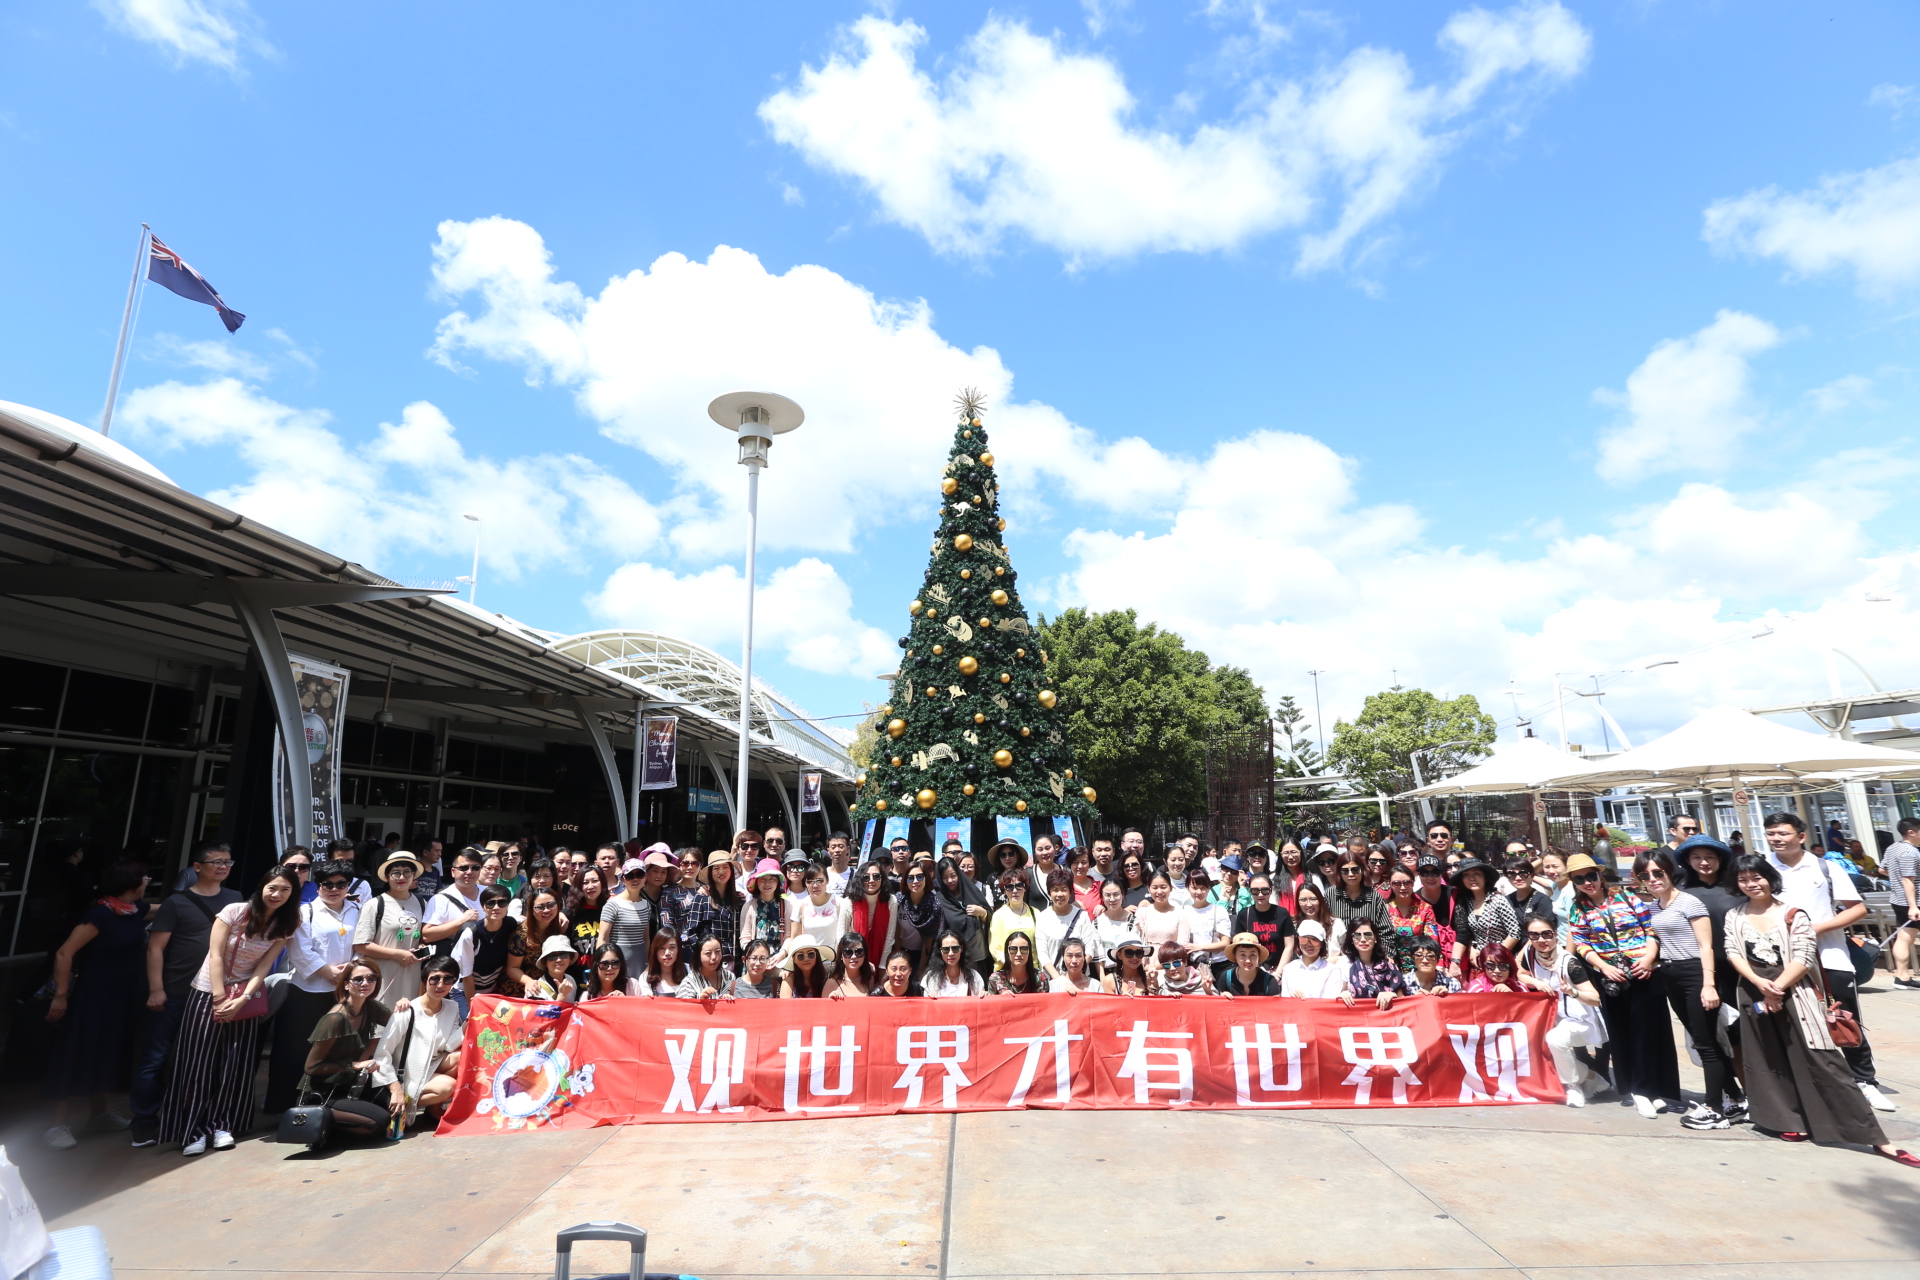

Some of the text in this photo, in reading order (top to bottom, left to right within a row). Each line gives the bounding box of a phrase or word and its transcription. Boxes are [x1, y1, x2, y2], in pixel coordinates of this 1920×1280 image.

[313, 810, 325, 820] TO
[313, 824, 329, 834] THE
[661, 1019, 1538, 1114] 观世界才有世界观
